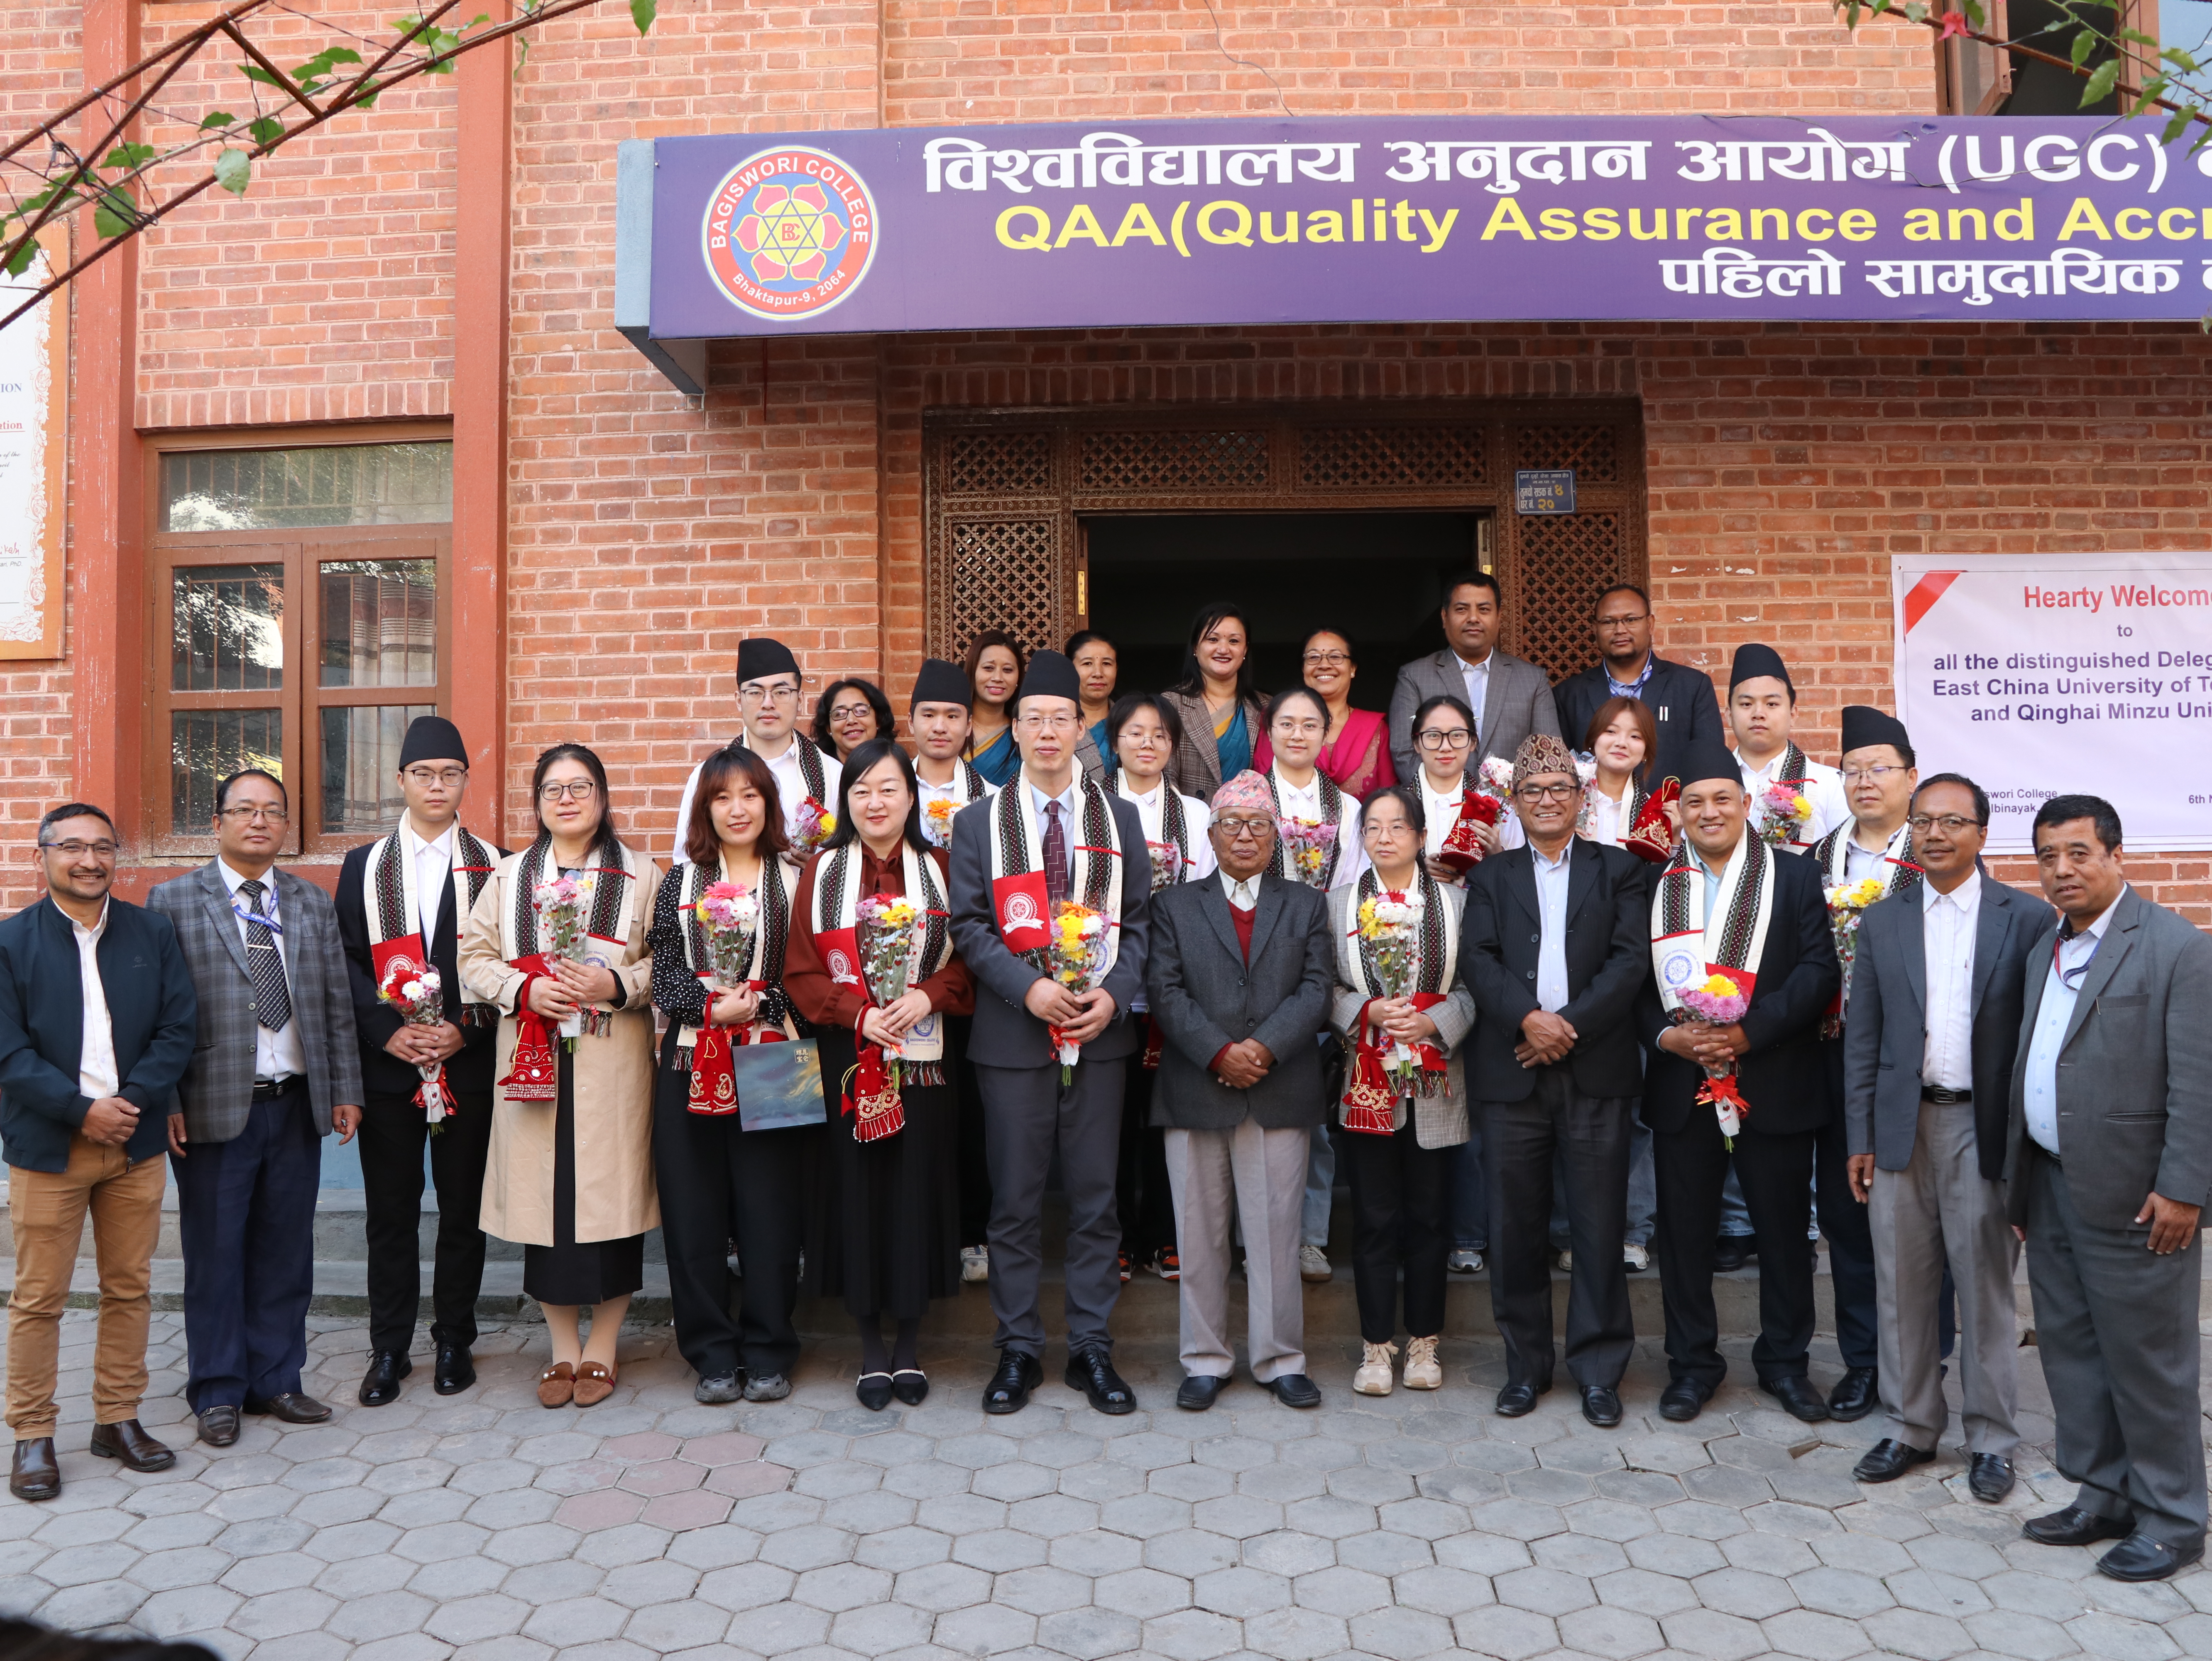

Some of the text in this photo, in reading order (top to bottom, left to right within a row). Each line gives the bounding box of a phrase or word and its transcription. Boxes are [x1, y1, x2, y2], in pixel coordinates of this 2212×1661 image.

[923, 132, 1360, 194] विश्वविद्यालय
[1384, 141, 1652, 194] अनुदान
[1675, 128, 1910, 182] आयोग
[1938, 134, 2168, 194] (UGC)
[711, 157, 869, 248] BAGISWORI COLLEGE
[1480, 197, 1877, 242] Assurance
[1904, 198, 2034, 241] and
[1659, 247, 1846, 298] पहिलो
[1865, 247, 2183, 306] सामुदायिक
[733, 269, 846, 307] Bhaktapur-9, 2064
[1534, 488, 1546, 497] सडक
[1520, 500, 1528, 509] घर
[2024, 584, 2212, 613] Hearty Welcom
[2117, 624, 2133, 637] to
[1934, 654, 1957, 670] all
[1965, 653, 1999, 670] the
[2006, 652, 2150, 673] distinguished
[1933, 676, 2212, 698] East China University of T
[1971, 704, 2010, 721] and
[2017, 703, 2100, 725] Qinghai
[2108, 702, 2169, 719] Minzu
[1984, 789, 2058, 800] swori College
[2189, 794, 2205, 804] 6th
